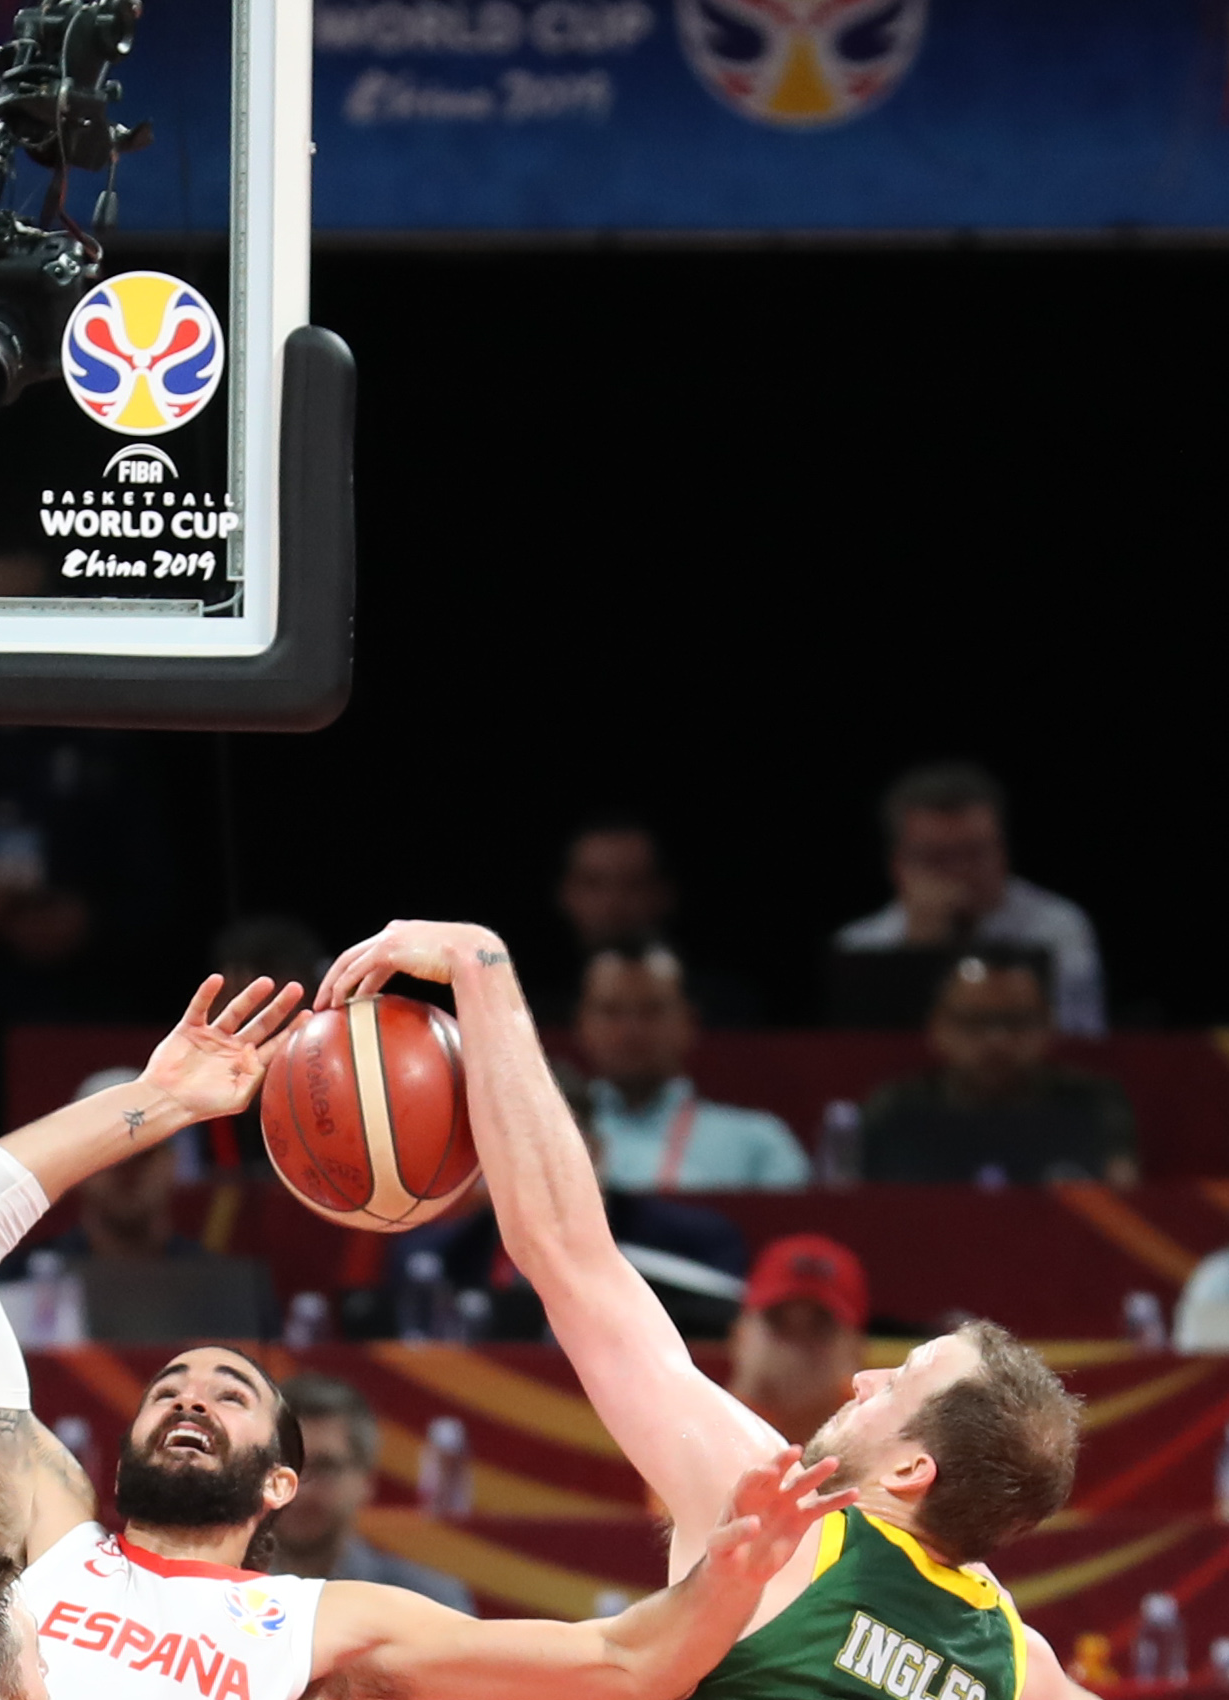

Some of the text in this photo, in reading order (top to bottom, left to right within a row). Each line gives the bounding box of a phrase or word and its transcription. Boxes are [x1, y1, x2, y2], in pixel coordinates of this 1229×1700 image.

[117, 460, 164, 484] FIBA
[41, 489, 236, 508] BASKETBALL
[39, 508, 240, 540] WORLD CUP
[60, 549, 218, 582] China 2019
